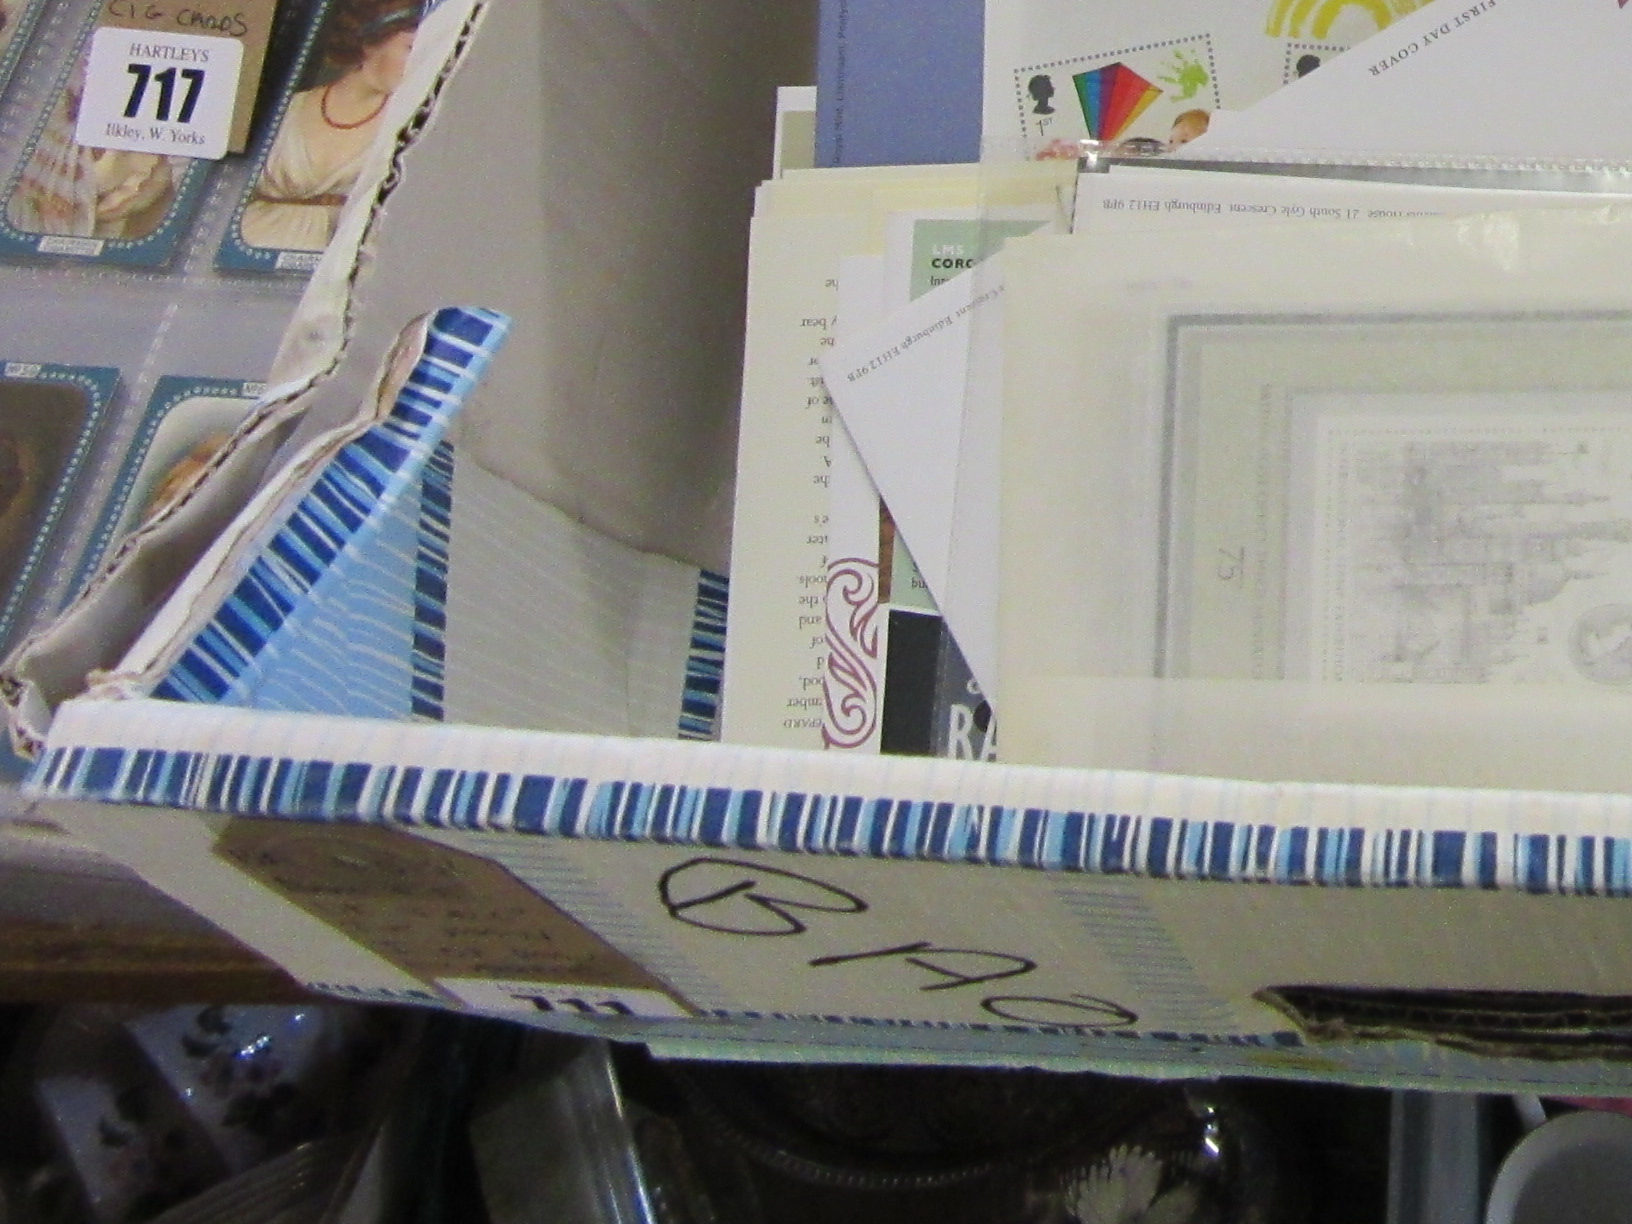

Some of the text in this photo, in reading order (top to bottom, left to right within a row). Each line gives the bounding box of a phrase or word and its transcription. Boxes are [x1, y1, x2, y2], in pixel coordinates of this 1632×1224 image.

[1422, 22, 1452, 48] DAY
[129, 41, 210, 64] HARTLEYS
[1368, 41, 1420, 78] COVER
[123, 63, 206, 124] 717
[170, 127, 206, 147] Yorks
[1128, 198, 1161, 212] EH12
[1164, 199, 1222, 215] Edinburgh
[1228, 202, 1278, 216] Crescent
[1280, 204, 1306, 218] Gyle
[1308, 206, 1342, 219] South
[800, 318, 827, 333] bear
[900, 315, 954, 351] Edinburgh
[869, 345, 901, 371] EH12
[798, 616, 823, 629] and
